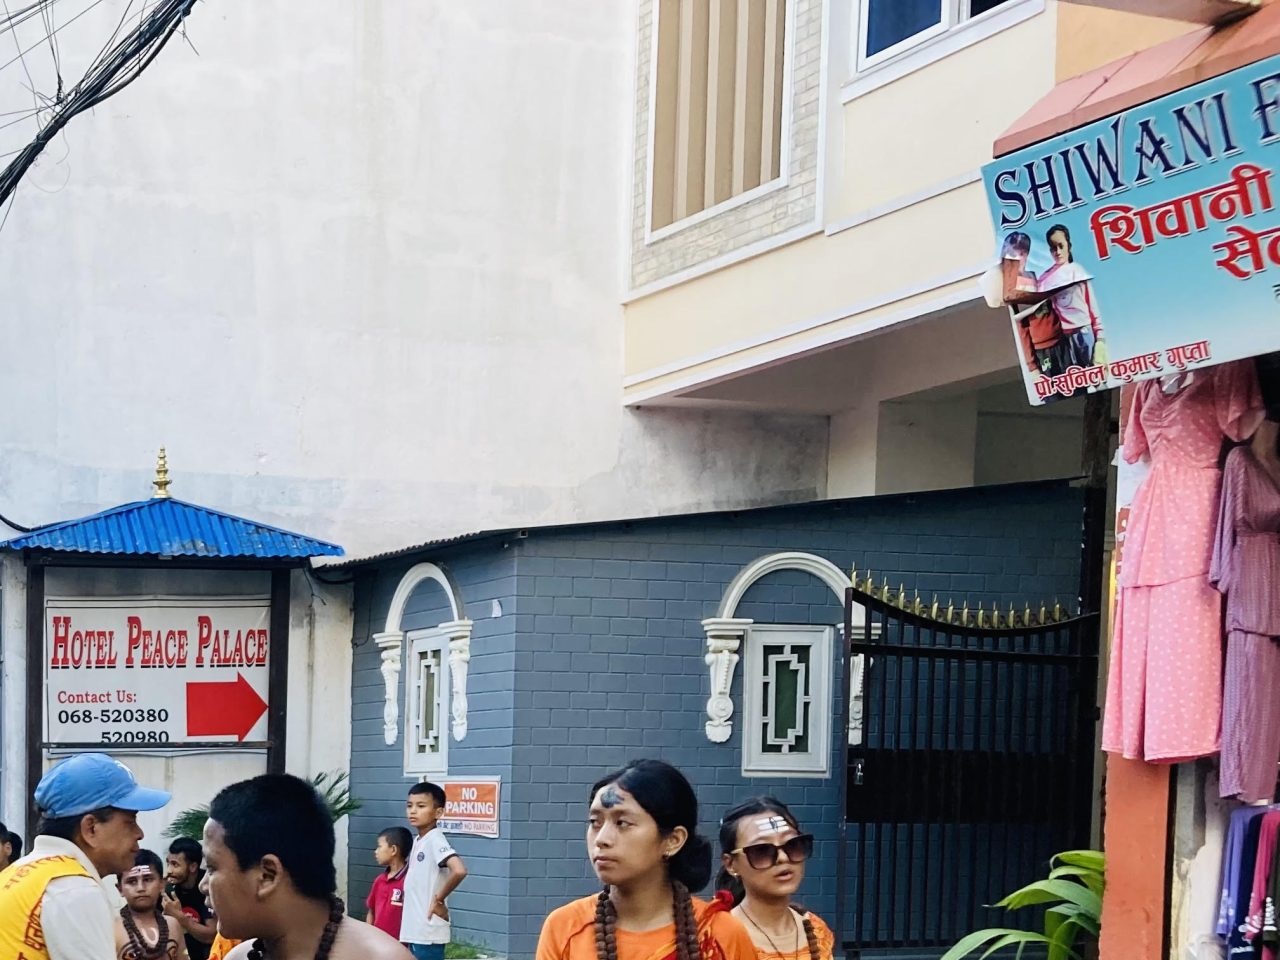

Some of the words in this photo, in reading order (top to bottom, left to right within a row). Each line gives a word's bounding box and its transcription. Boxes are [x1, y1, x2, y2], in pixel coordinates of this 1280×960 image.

[994, 92, 1244, 228] SHIWANI
[1090, 165, 1272, 260] शिवानी
[1110, 351, 1161, 383] कुमार
[1166, 340, 1211, 368] गुप्ता
[51, 615, 118, 670] HOTEL
[125, 615, 189, 669] PEACE
[195, 615, 268, 669] PALACE
[57, 690, 113, 704] Contact
[116, 690, 138, 704] Us:
[58, 708, 169, 724] 068-520380
[101, 730, 170, 743] 520980
[461, 787, 478, 800] NO
[445, 802, 495, 815] PARKING
